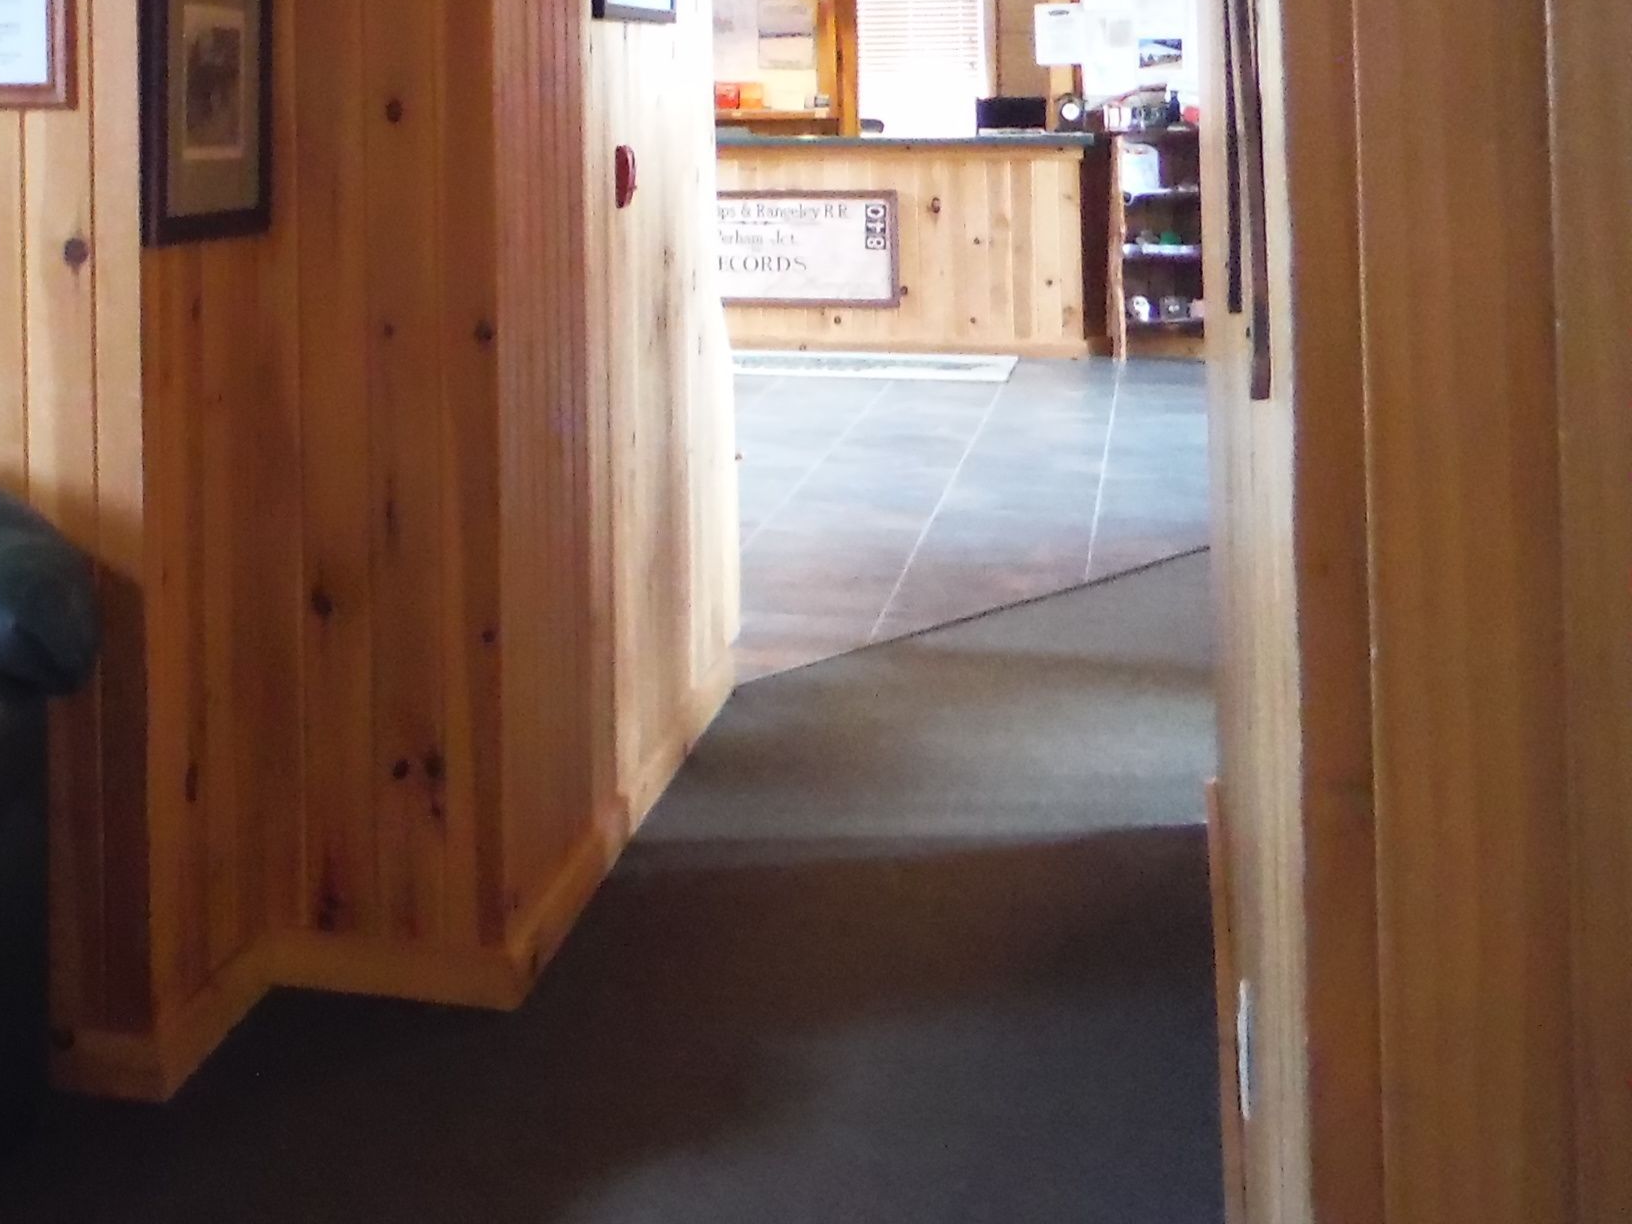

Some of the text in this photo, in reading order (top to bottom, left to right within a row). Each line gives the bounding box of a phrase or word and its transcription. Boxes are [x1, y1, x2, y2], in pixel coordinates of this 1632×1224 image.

[740, 202, 752, 218] &
[756, 202, 821, 223] Rangeley
[866, 205, 886, 249] 840
[717, 255, 808, 273] ECORDS
